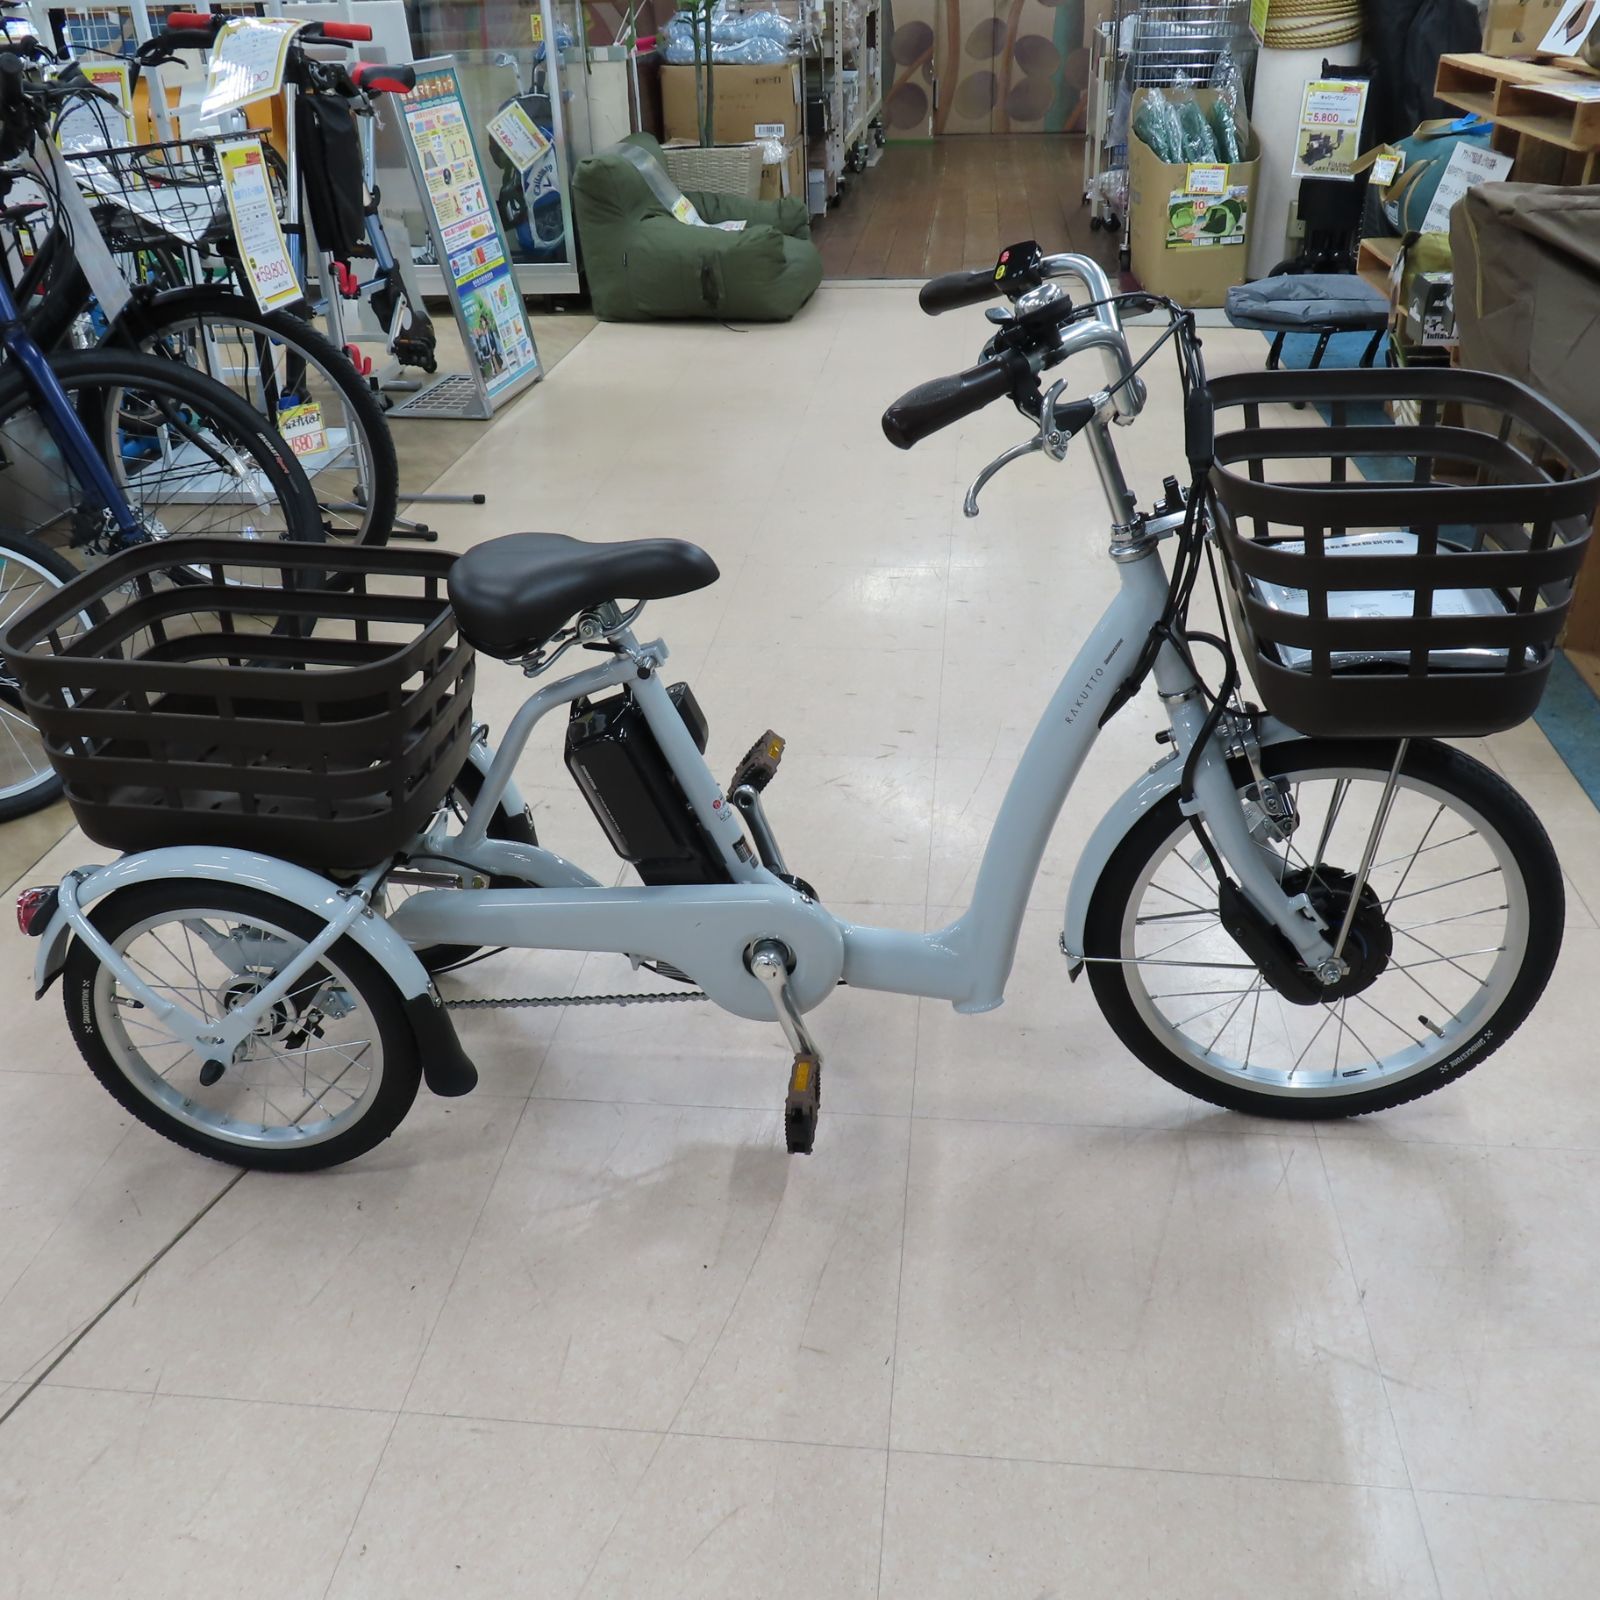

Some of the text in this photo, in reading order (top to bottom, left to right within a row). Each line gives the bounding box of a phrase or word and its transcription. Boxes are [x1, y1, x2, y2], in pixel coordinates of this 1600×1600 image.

[1065, 668, 1104, 725] RAKUTTO
[81, 988, 92, 1024] BRIDGESTONE
[1448, 1037, 1487, 1068] BRIDGESTONE
